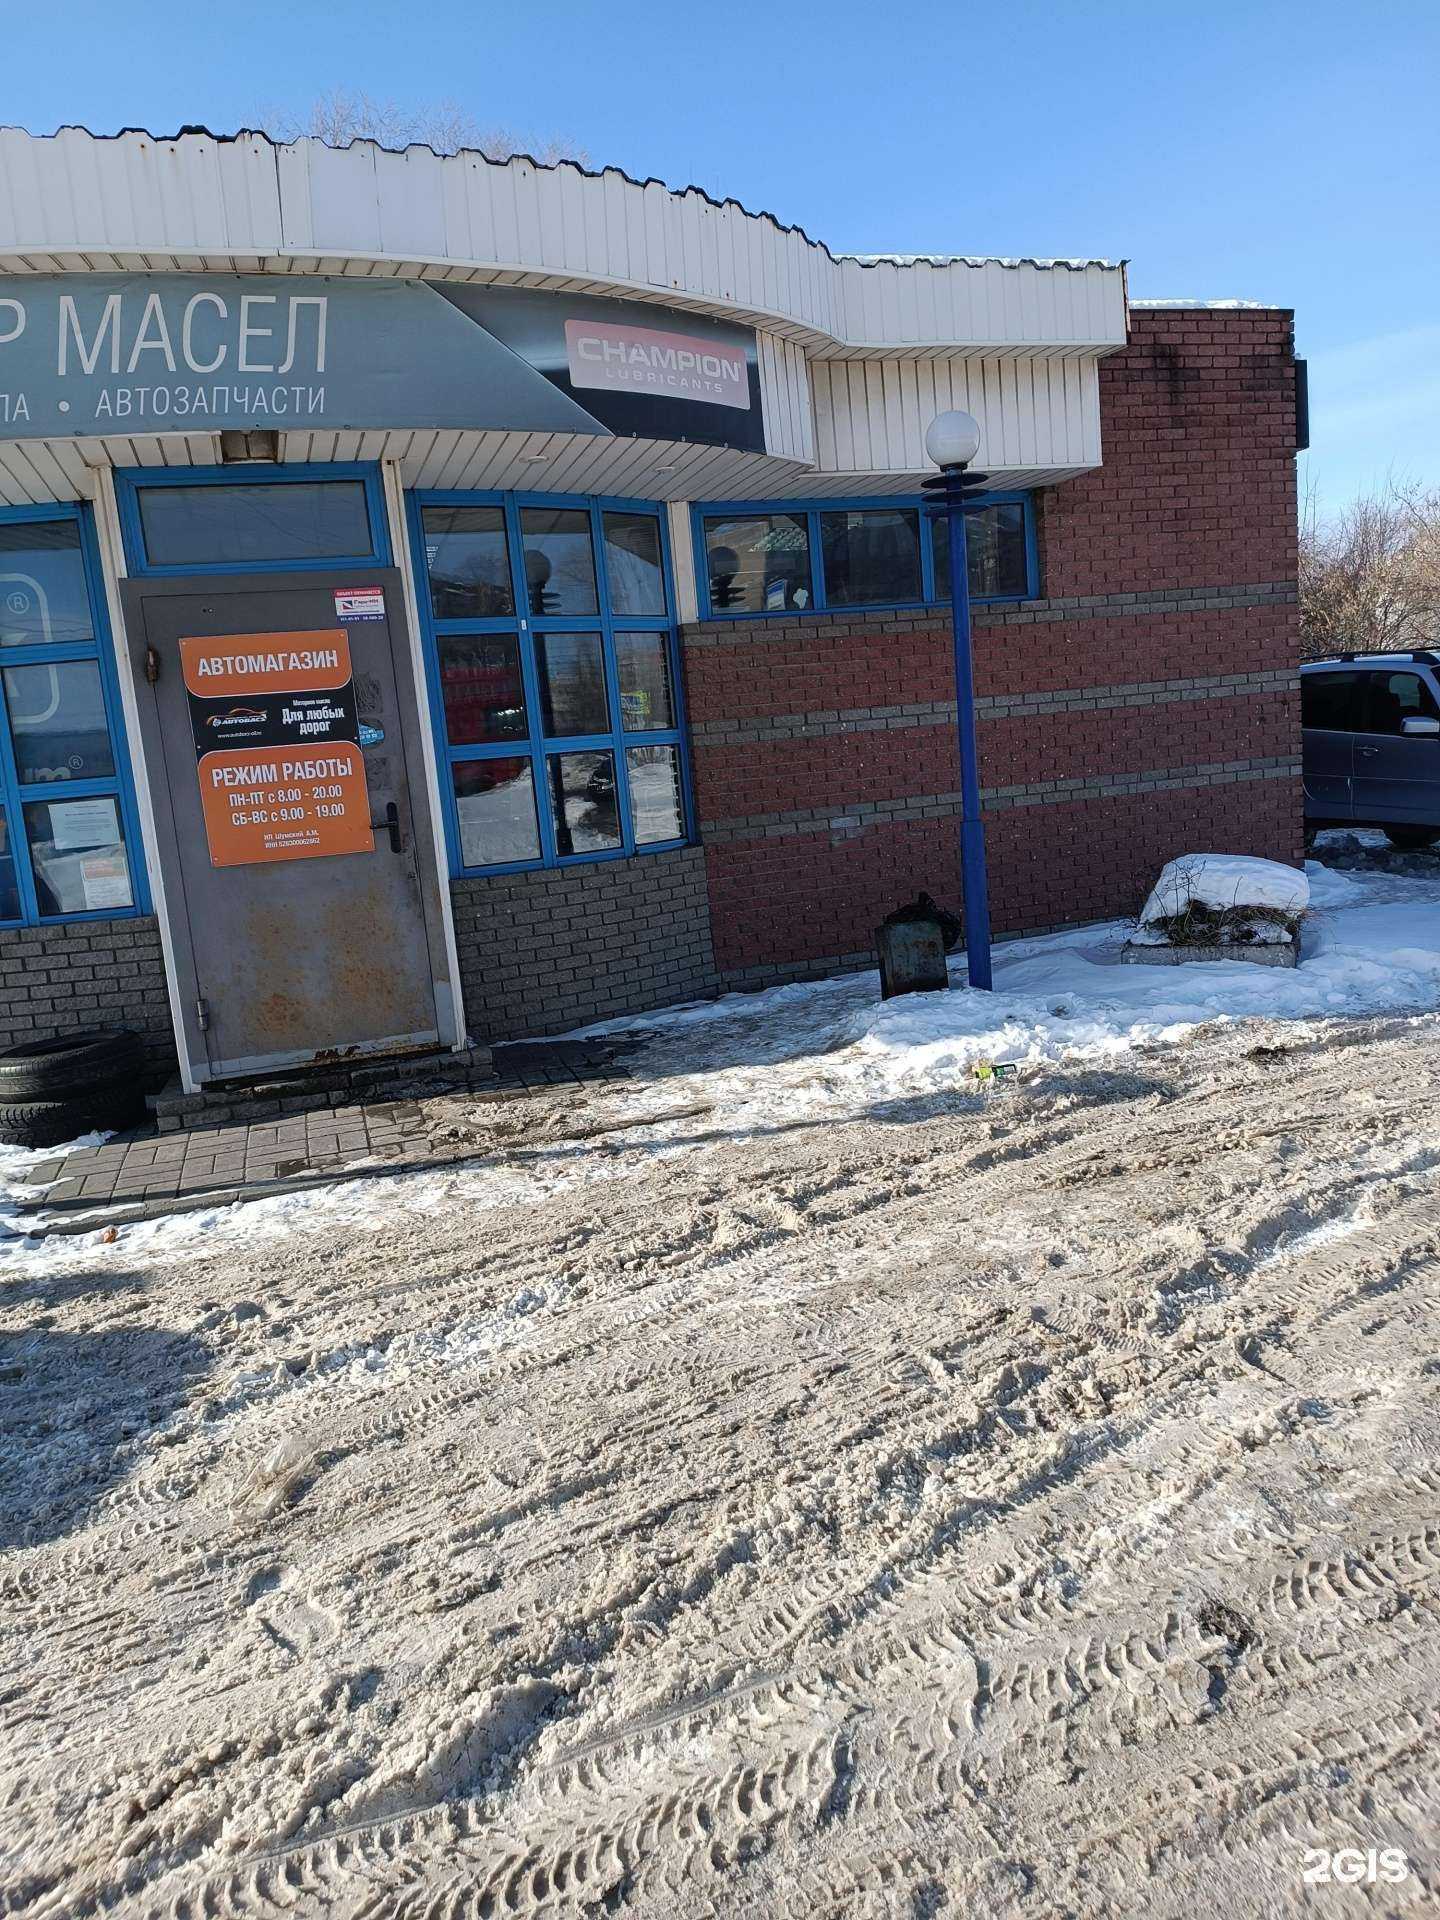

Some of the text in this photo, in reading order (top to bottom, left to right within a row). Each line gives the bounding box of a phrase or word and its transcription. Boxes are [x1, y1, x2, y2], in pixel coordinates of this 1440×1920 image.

[57, 292, 328, 376] МАСЕЛ
[576, 337, 741, 382] CHAMPION
[605, 367, 724, 393] LUBRICANTS
[95, 387, 326, 419] АВТОЗАПЧАСТИ
[198, 649, 339, 677] АВТОМАГАЗИН
[282, 705, 345, 725] Для любых
[299, 720, 332, 736] дорог
[212, 757, 353, 788] РЕЖИМ РАБОТЫ
[229, 791, 265, 807] ПН-ПТ
[268, 793, 276, 804] с
[278, 788, 302, 803] 8.00
[312, 784, 343, 800] 20.00
[231, 810, 268, 826] СБ-ВС
[271, 812, 278, 822] с
[280, 806, 305, 821] 9.00
[315, 803, 345, 818] 19.00
